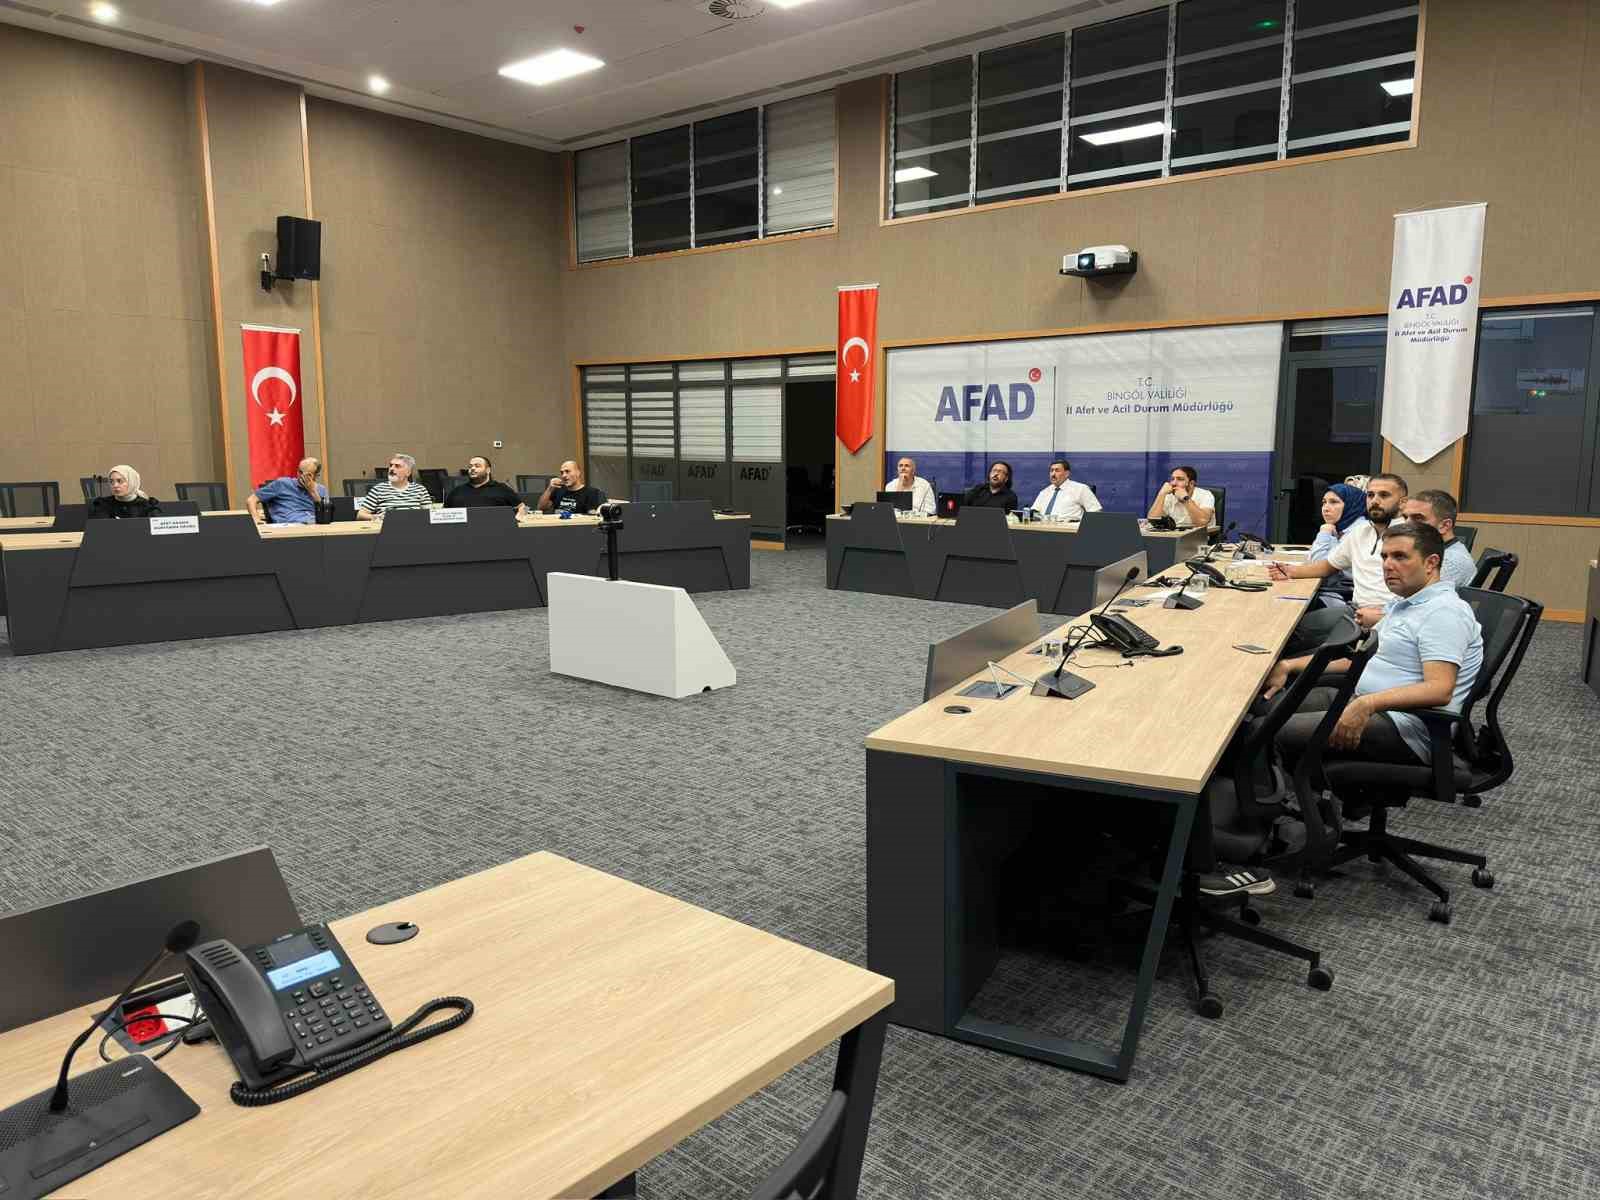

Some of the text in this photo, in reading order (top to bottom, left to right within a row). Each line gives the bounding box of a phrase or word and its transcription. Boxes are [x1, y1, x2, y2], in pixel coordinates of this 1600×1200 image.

[1396, 285, 1468, 309] AFAD
[935, 383, 1035, 421] AFAD
[1075, 405, 1095, 415] Afet
[1112, 404, 1131, 414] Acil
[1134, 404, 1169, 413] Durum
[1172, 400, 1233, 413] Müdürlüğü
[687, 465, 715, 480] AFAD
[740, 467, 769, 481] AFAD
